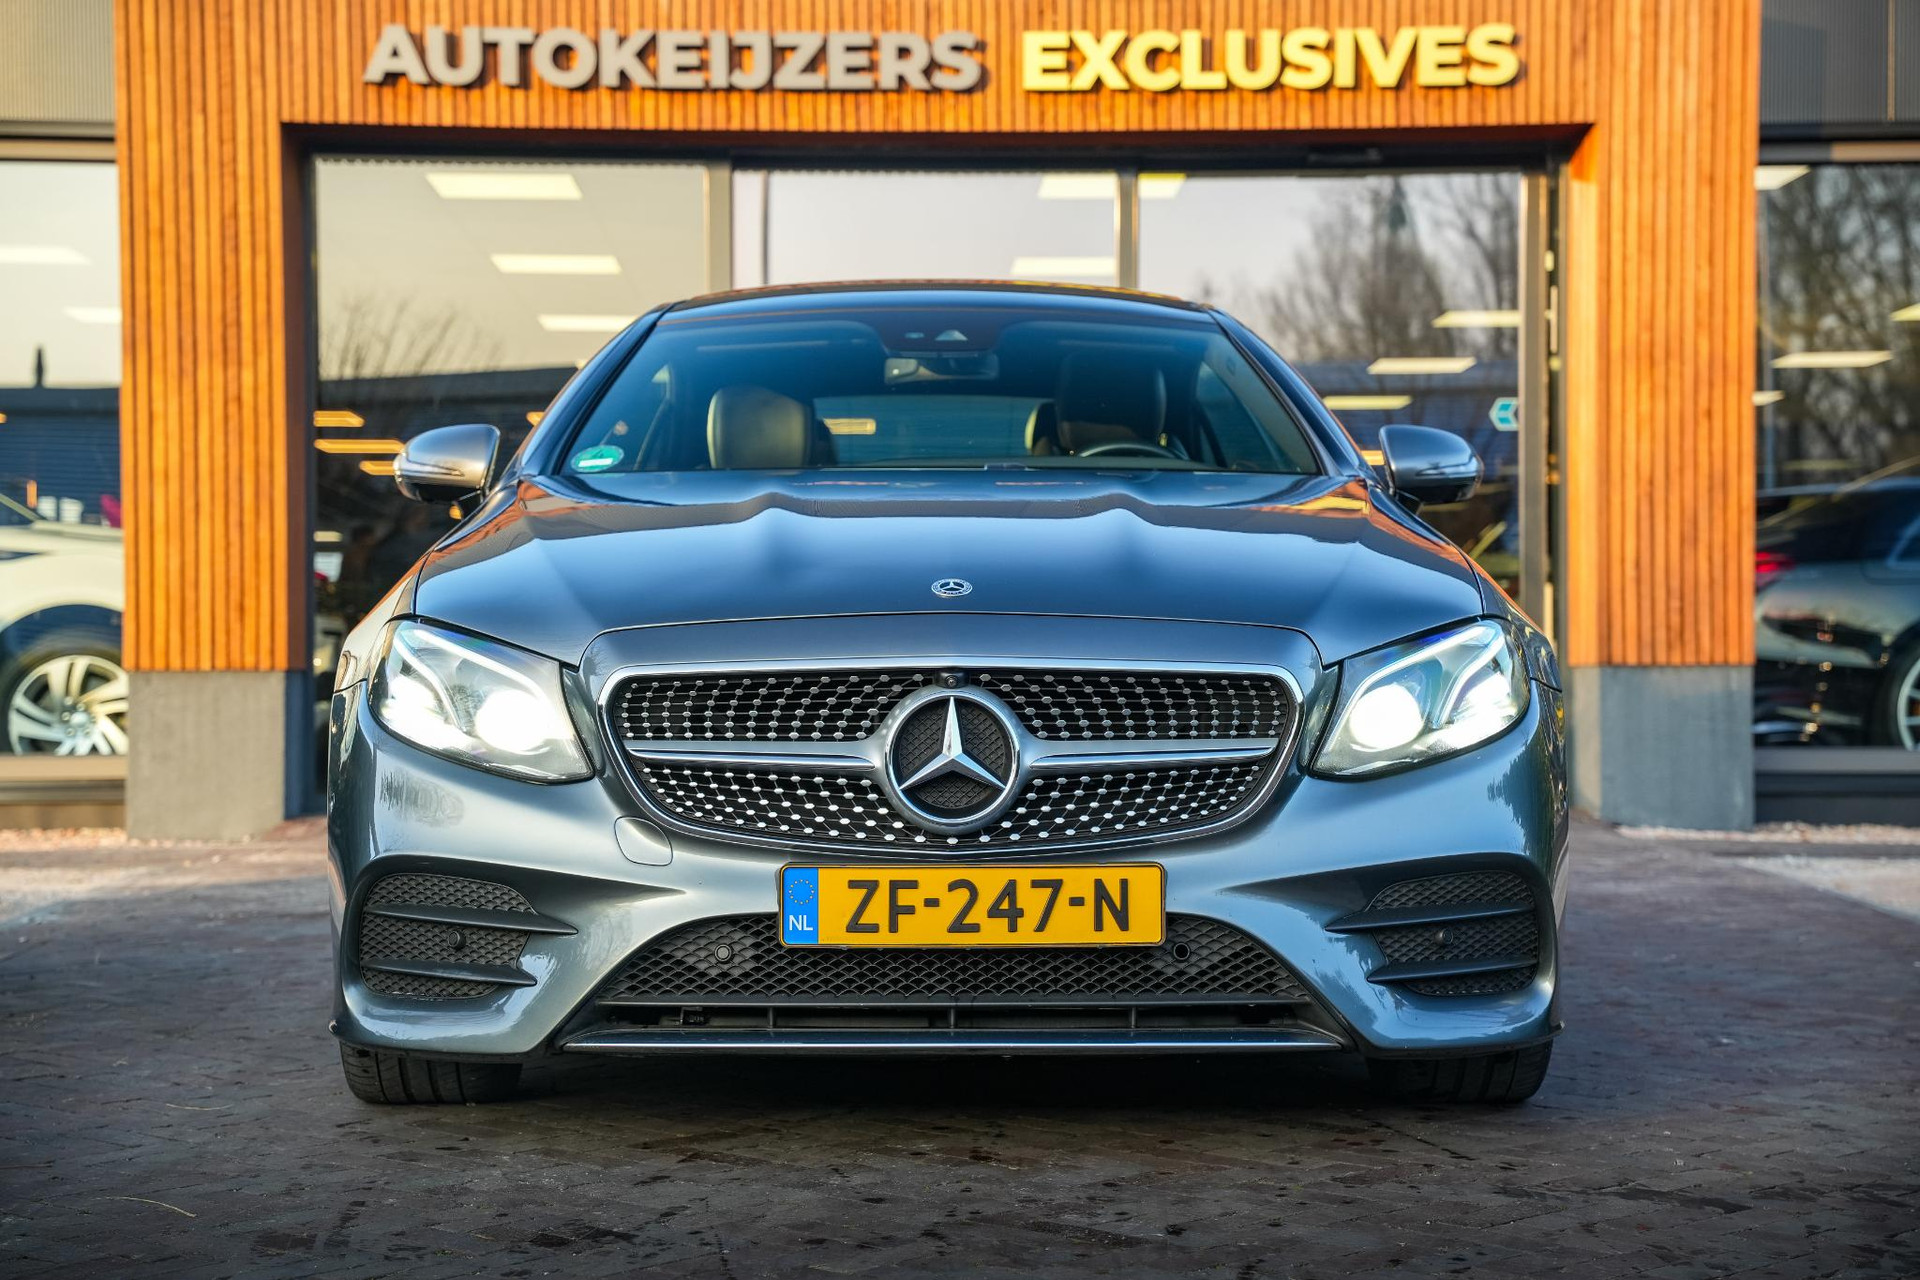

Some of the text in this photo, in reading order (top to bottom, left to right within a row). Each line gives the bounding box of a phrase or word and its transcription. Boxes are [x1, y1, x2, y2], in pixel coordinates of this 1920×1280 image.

[363, 23, 1519, 91] AUTOKEIJZERS EXCLUSIVES
[789, 914, 814, 931] NL
[845, 878, 1130, 933] ZF-247-N
